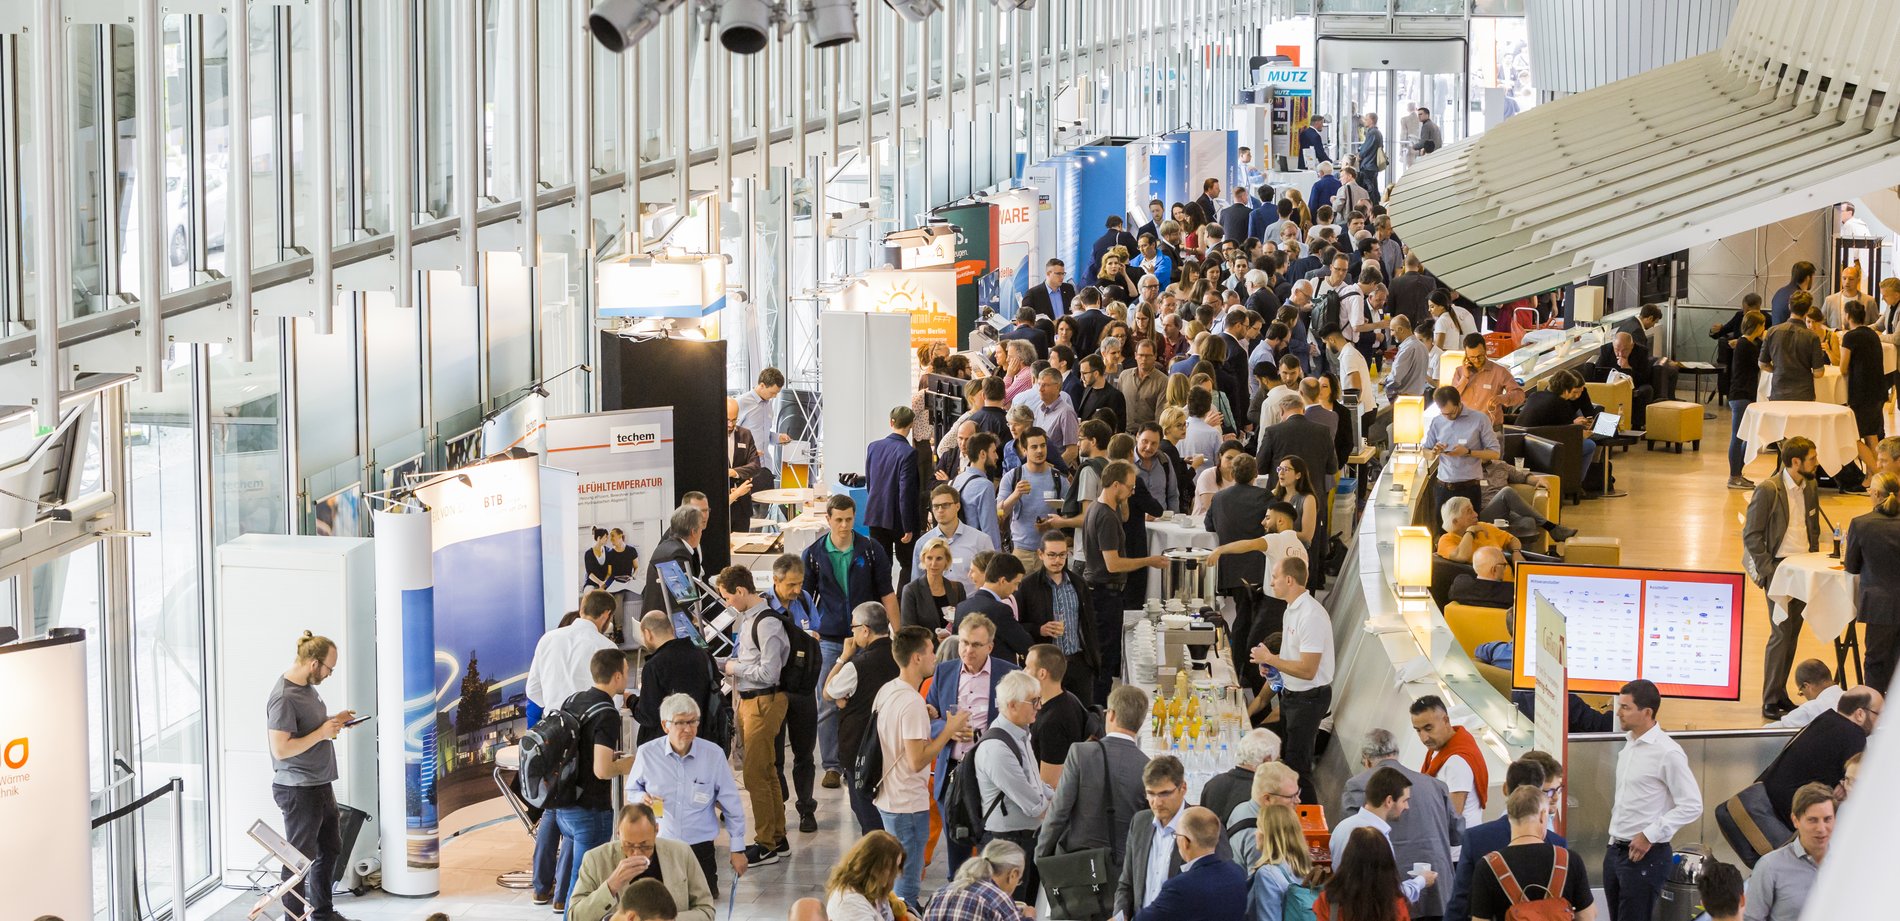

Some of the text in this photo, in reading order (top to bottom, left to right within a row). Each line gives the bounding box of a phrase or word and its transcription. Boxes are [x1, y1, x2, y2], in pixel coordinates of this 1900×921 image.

[1267, 71, 1308, 82] MUTZ
[928, 327, 946, 335] Berlin
[617, 432, 655, 443] techem
[483, 494, 503, 508] BTB
